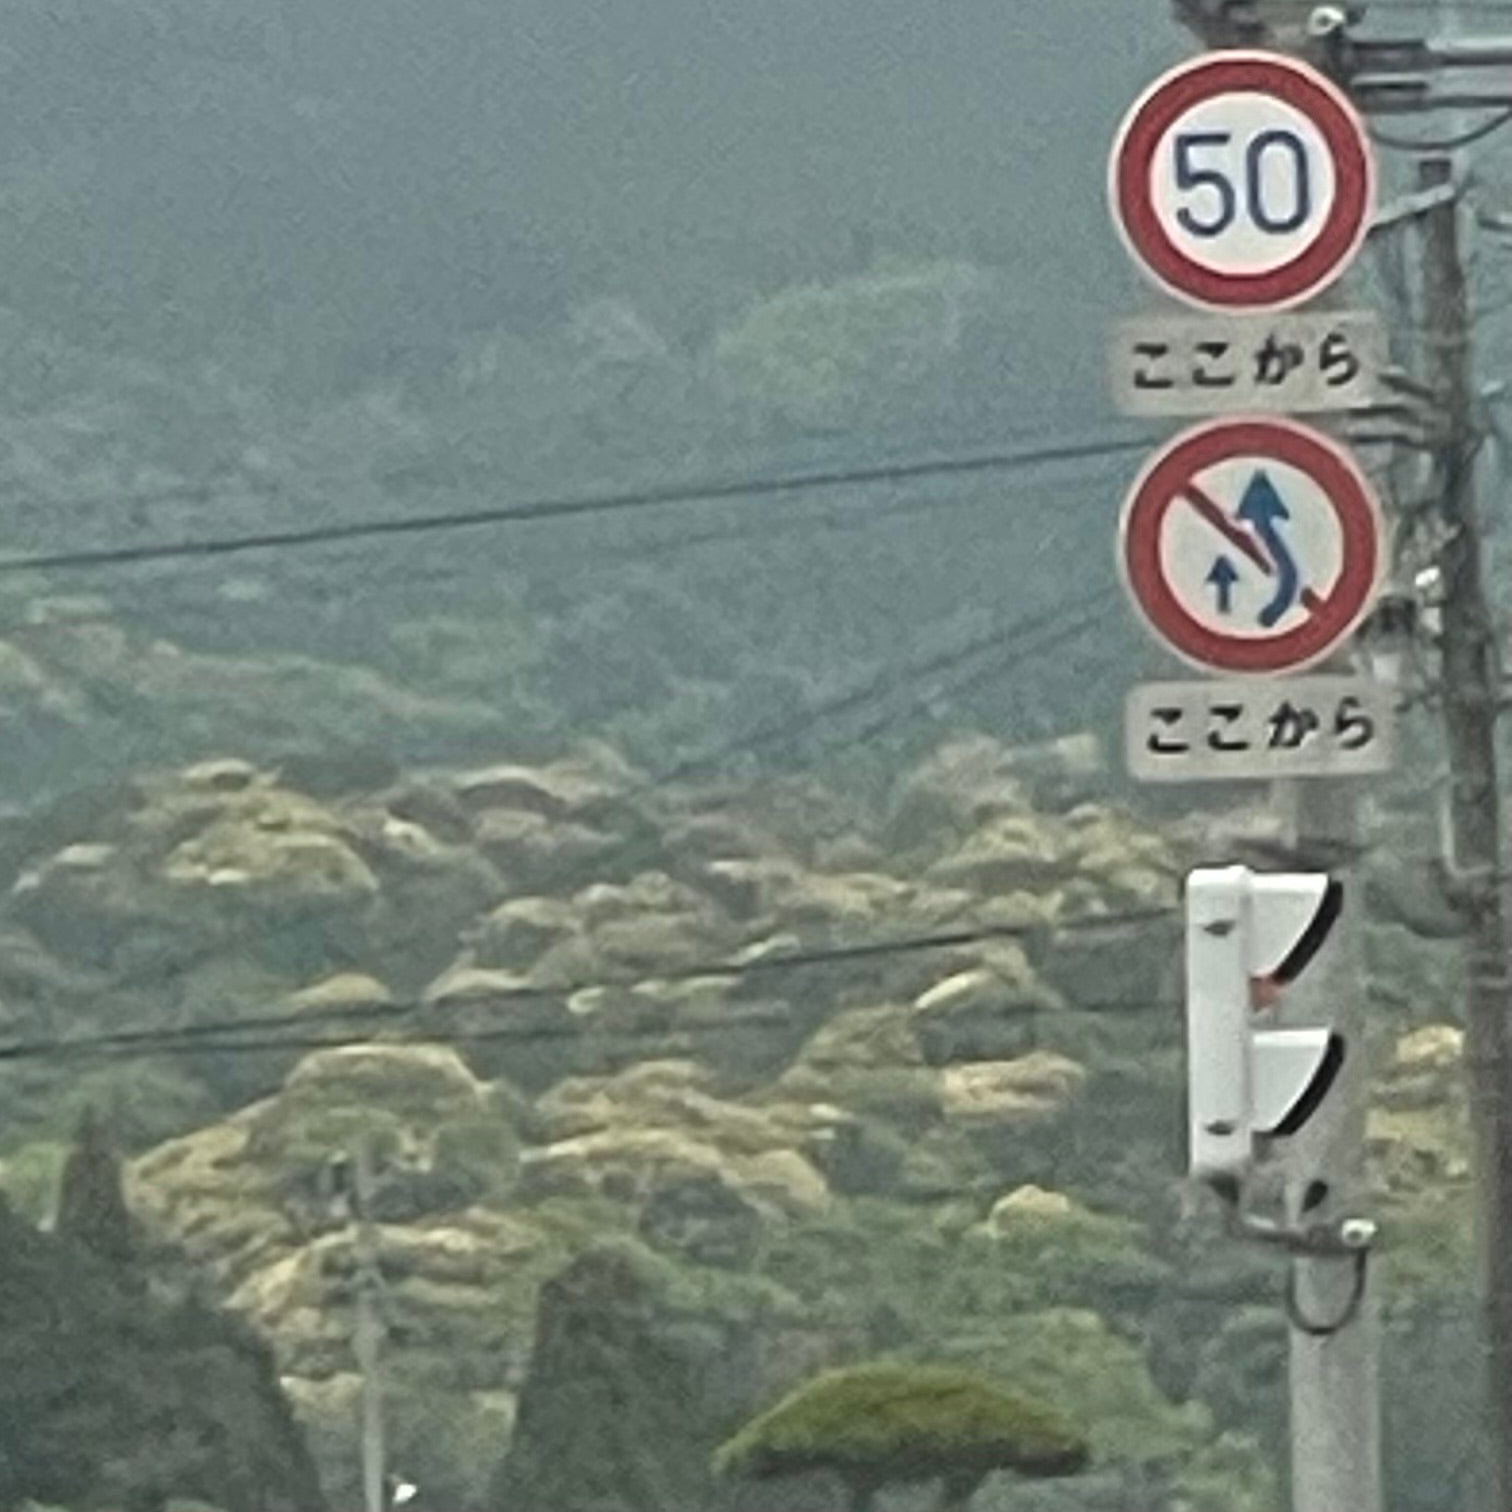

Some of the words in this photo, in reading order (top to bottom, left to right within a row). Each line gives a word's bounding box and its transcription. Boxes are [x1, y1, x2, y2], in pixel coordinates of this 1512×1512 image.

[1174, 129, 1310, 237] 50
[1133, 332, 1360, 389] ここから
[1146, 695, 1375, 754] ここから
